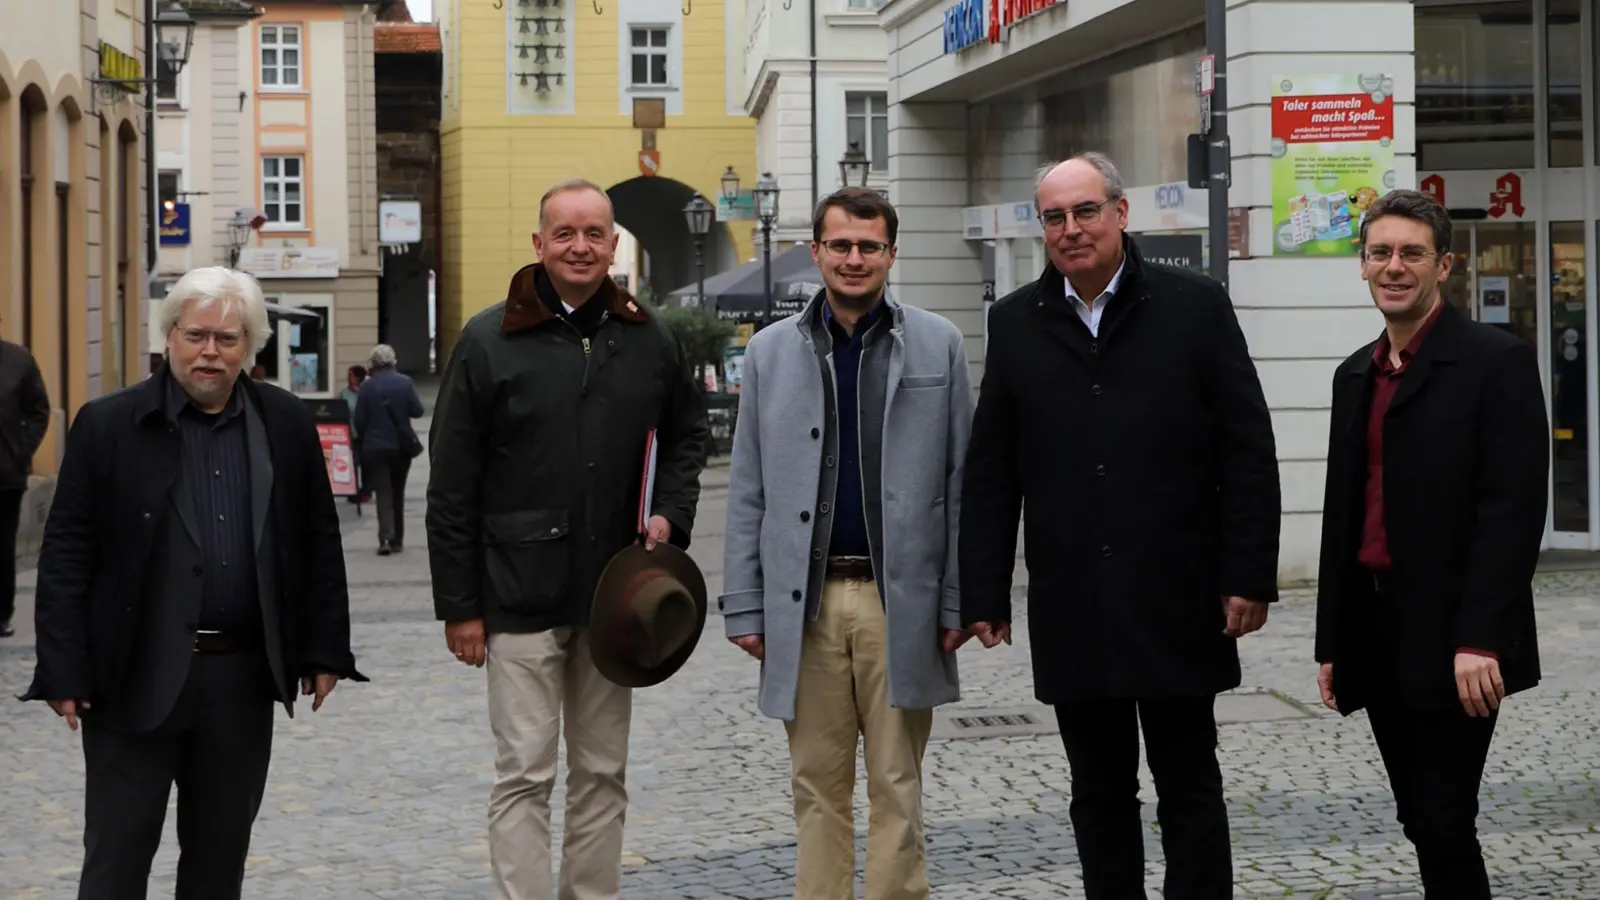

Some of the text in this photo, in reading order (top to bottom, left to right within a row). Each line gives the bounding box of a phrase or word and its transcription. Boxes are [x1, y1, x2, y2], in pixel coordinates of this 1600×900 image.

[1283, 97, 1361, 111] Taler sammeln
[1311, 109, 1385, 124] macht Spaß...
